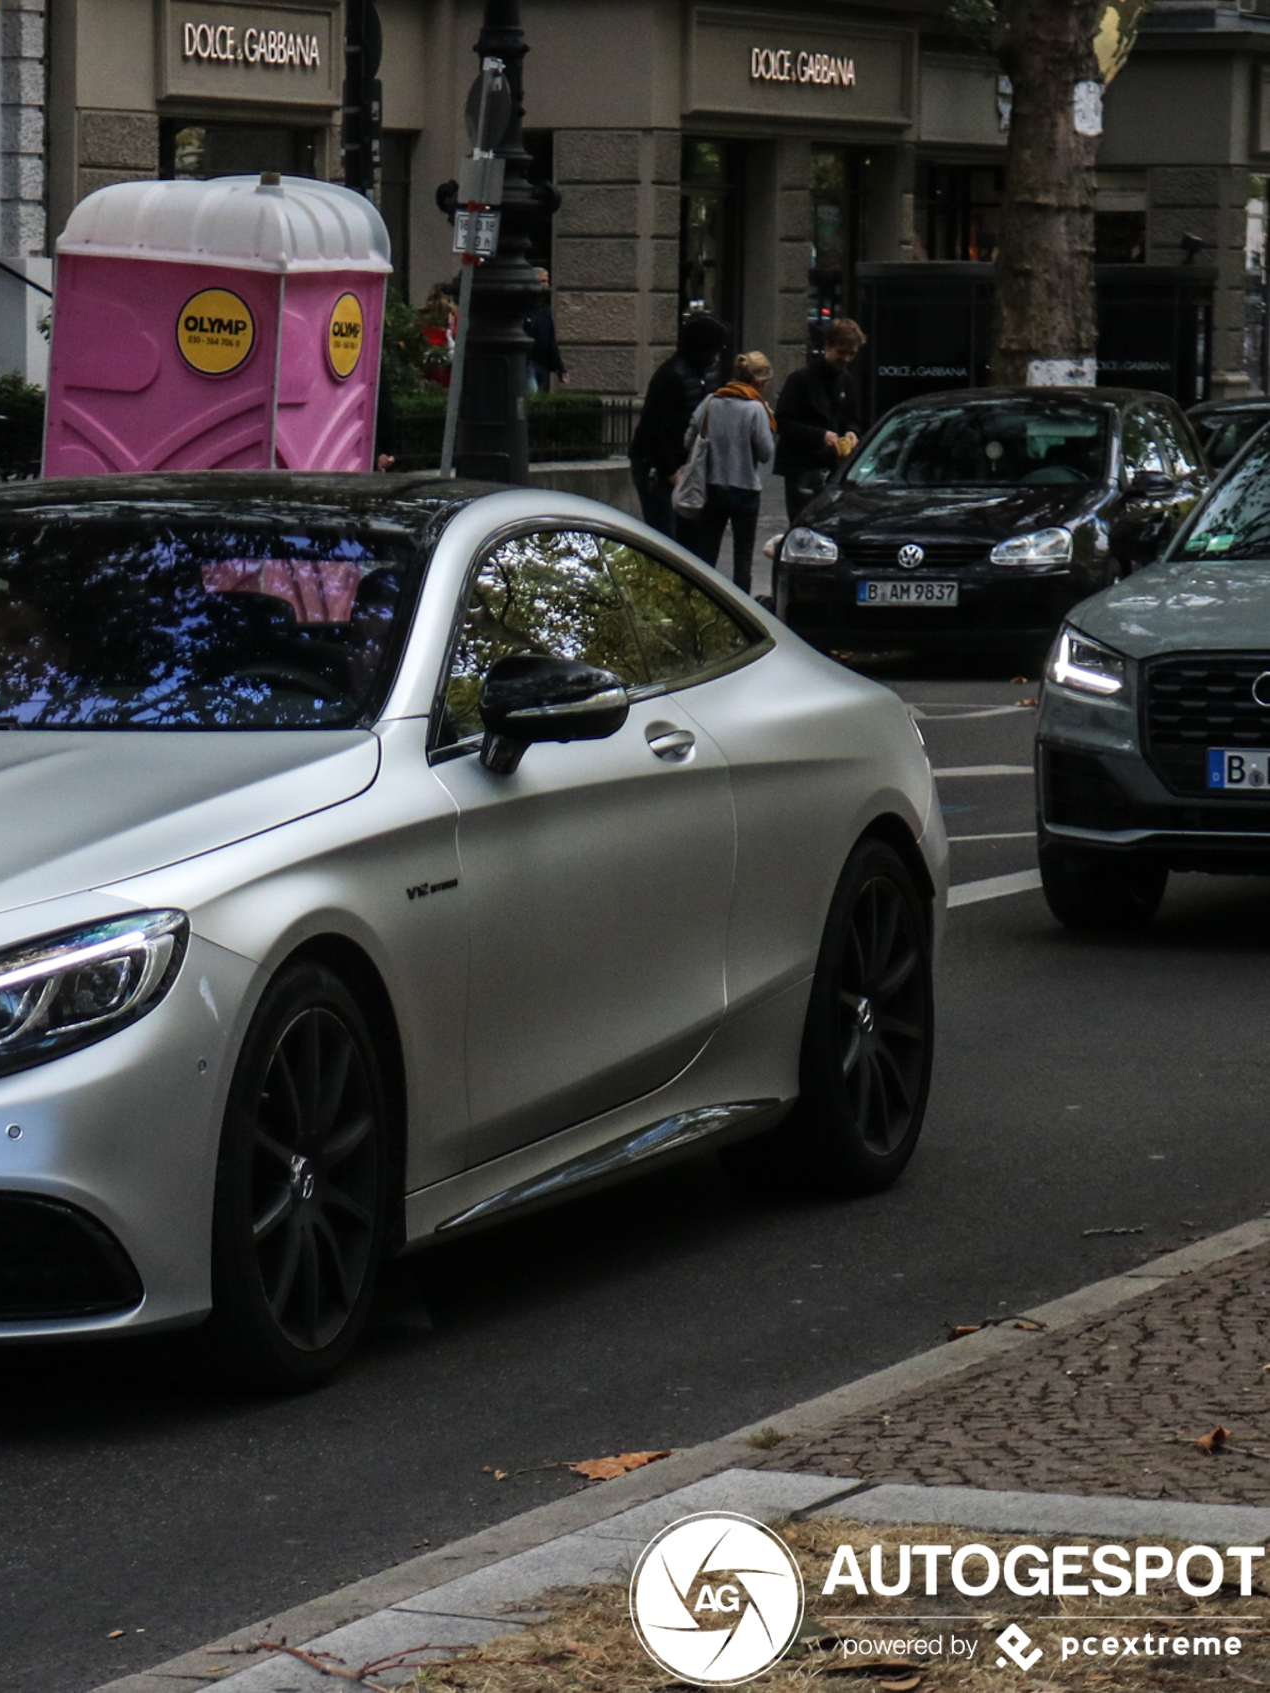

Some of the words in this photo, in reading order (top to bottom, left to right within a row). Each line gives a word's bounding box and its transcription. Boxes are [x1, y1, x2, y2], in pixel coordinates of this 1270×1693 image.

[184, 22, 235, 60] DOLCE
[236, 43, 243, 60] &
[244, 27, 320, 66] GABBANA
[751, 47, 791, 80] DOLCE
[797, 51, 856, 86] GABBANA
[184, 315, 247, 335] OLYMP
[332, 321, 361, 338] OLYMP
[878, 365, 911, 377] DOLCE
[916, 365, 969, 377] GABBANA
[868, 584, 878, 600] B
[890, 584, 910, 600] AM
[914, 584, 955, 600] 9837
[1227, 755, 1246, 783] B
